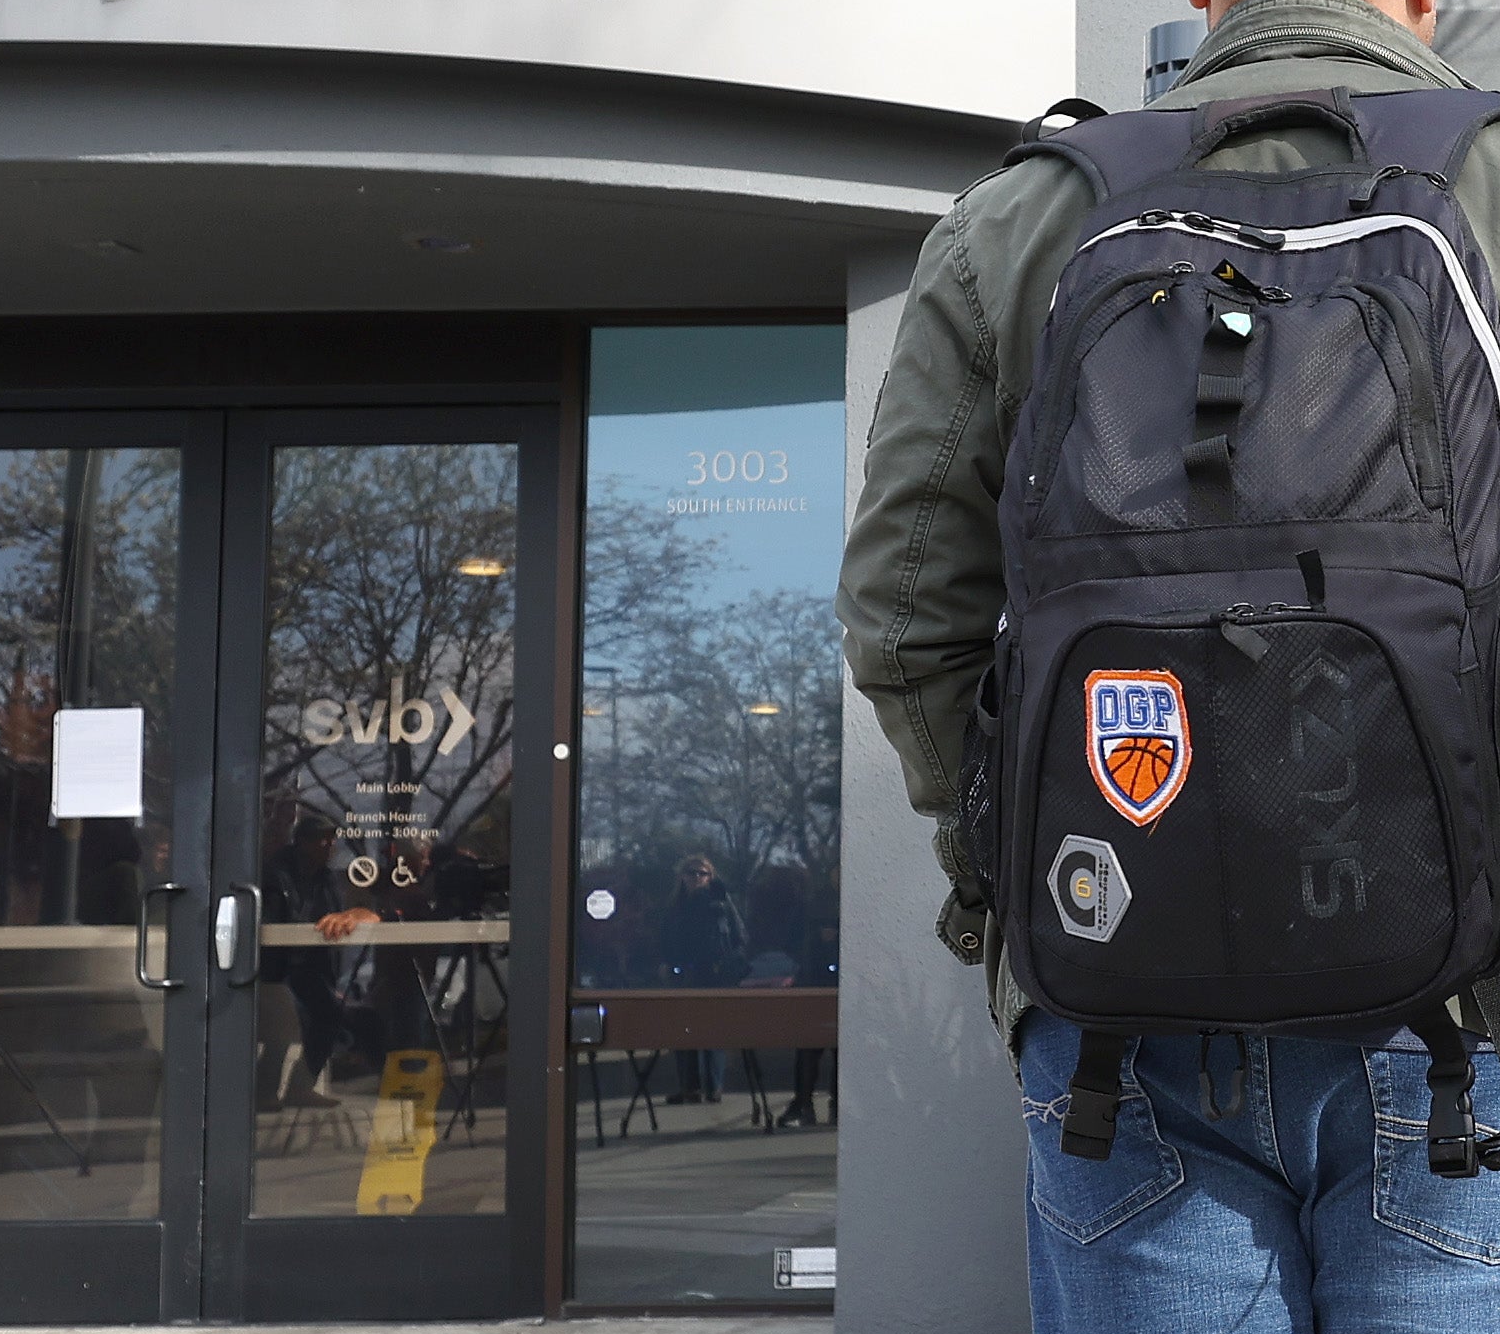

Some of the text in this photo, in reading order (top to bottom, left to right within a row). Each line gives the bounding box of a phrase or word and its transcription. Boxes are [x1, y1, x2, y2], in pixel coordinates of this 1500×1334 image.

[687, 449, 789, 486] 3003
[666, 496, 808, 514] SOUTH ENTRANCE
[303, 676, 434, 746] svb
[1095, 684, 1176, 732] OGP
[355, 782, 422, 795] Main Lobby
[346, 812, 427, 823] Branch Hours:
[336, 828, 361, 839] 9:00
[364, 829, 382, 839] am
[392, 828, 417, 838] 3:00
[420, 829, 439, 840] pm
